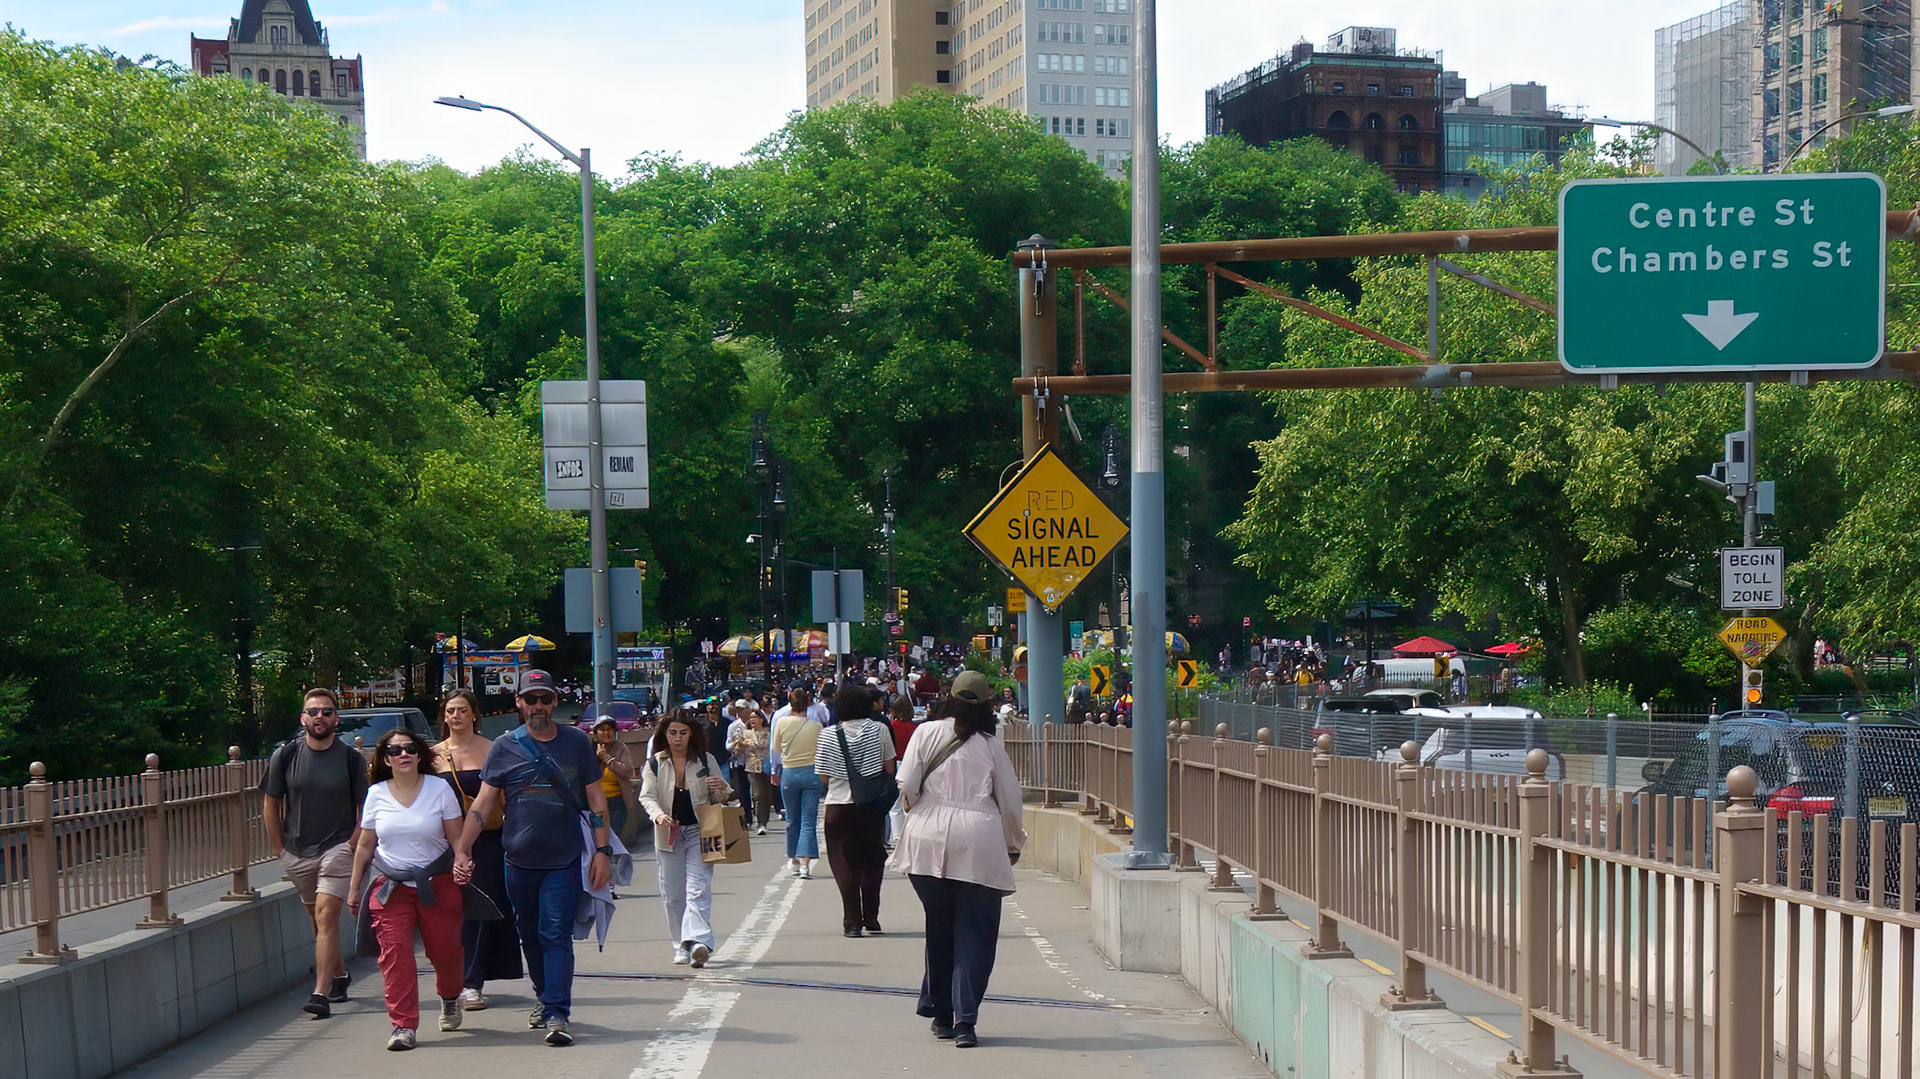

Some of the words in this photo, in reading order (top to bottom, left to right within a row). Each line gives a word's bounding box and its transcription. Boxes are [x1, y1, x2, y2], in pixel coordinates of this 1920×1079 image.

[1629, 201, 1755, 229] Centre
[1775, 198, 1815, 226] St
[1592, 244, 1789, 273] Chambers
[1812, 241, 1852, 268] St
[1027, 490, 1075, 511] RED
[1008, 517, 1099, 540] SIGNAL
[1011, 546, 1096, 568] AHEAD
[1730, 554, 1775, 566] BEGIN
[1734, 573, 1772, 584] TOLL
[1732, 590, 1773, 602] ZONE
[1737, 619, 1768, 629] ROAD
